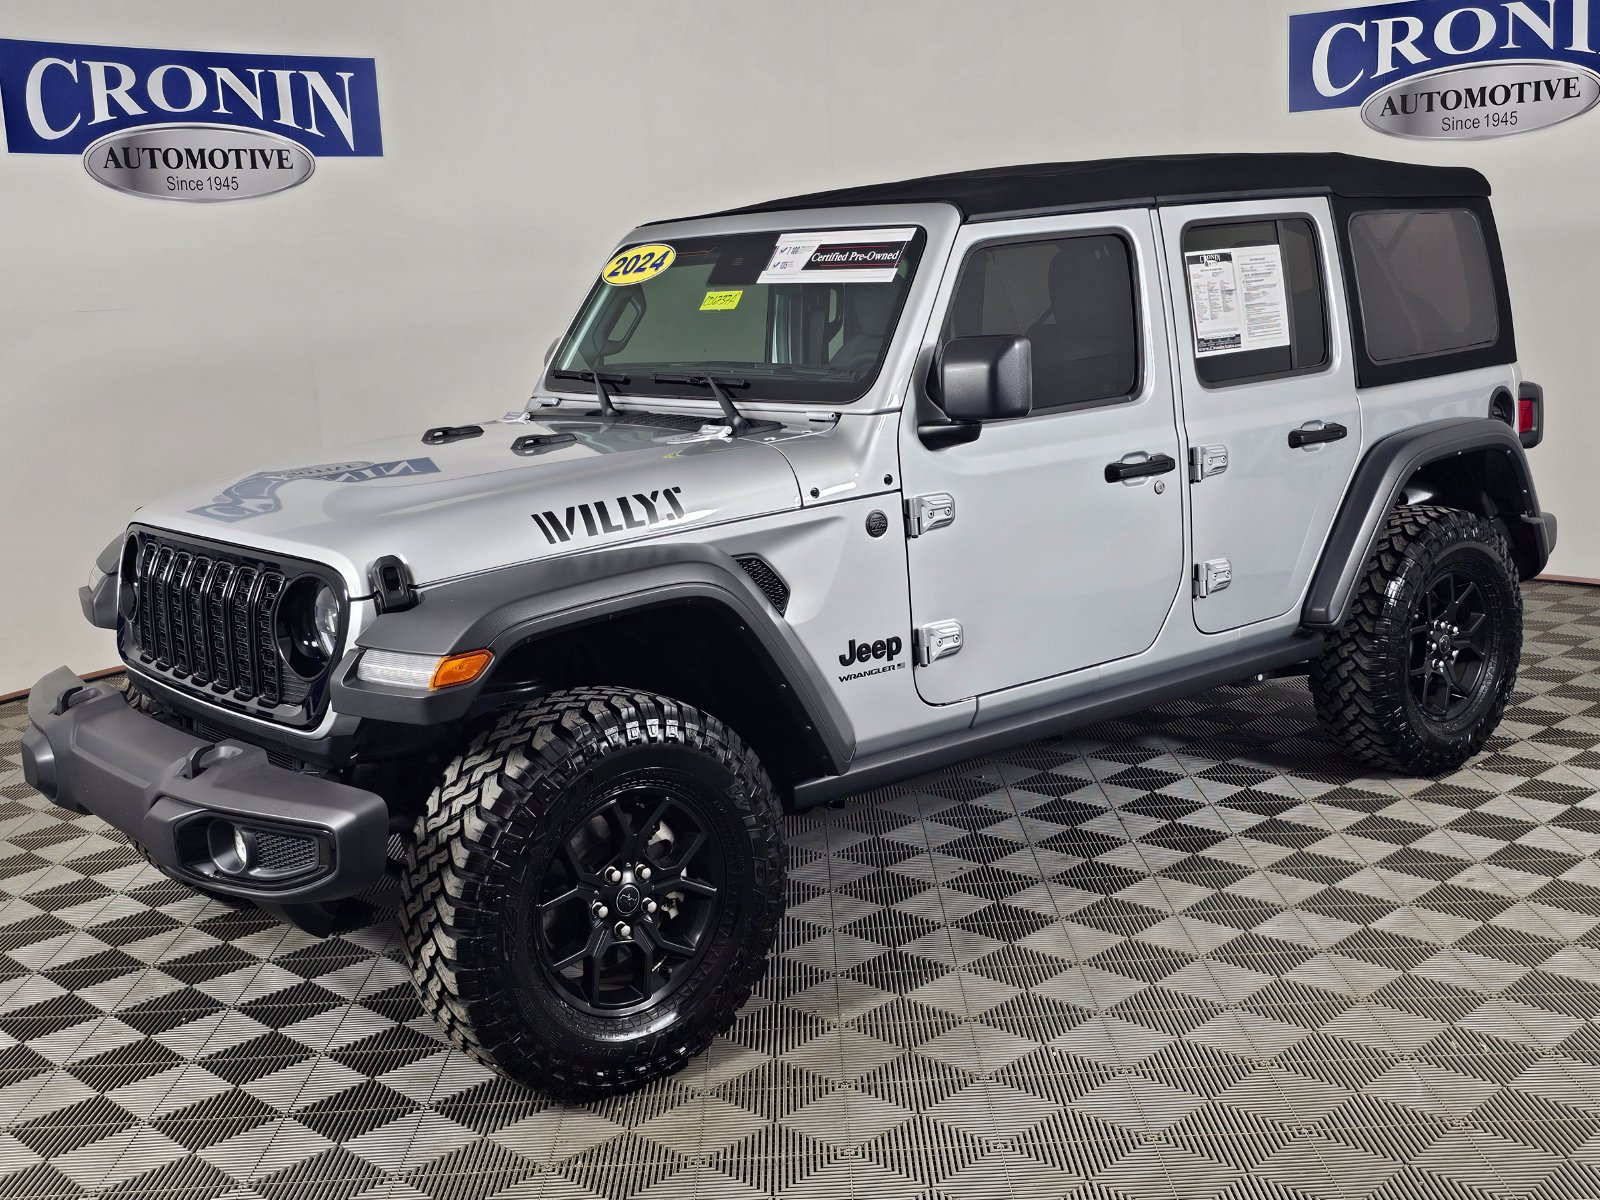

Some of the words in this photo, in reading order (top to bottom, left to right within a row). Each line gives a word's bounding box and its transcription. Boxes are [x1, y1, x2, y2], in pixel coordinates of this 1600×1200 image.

[1312, 0, 1600, 97] CRONI
[26, 57, 354, 151] CRONIN
[1380, 76, 1581, 117] AUTOMOTIVE
[1441, 115, 1480, 132] Since
[1484, 111, 1518, 127] 1945
[103, 147, 294, 171] AUTOMOTIVE
[166, 176, 204, 191] Since
[207, 176, 239, 191] 1945
[607, 250, 671, 278] 2024
[811, 252, 848, 263] Certified
[849, 250, 899, 261] Pre-Owned
[531, 486, 685, 544] WILLYS
[838, 636, 902, 666] Jeep
[838, 664, 895, 682] WRANGLER
